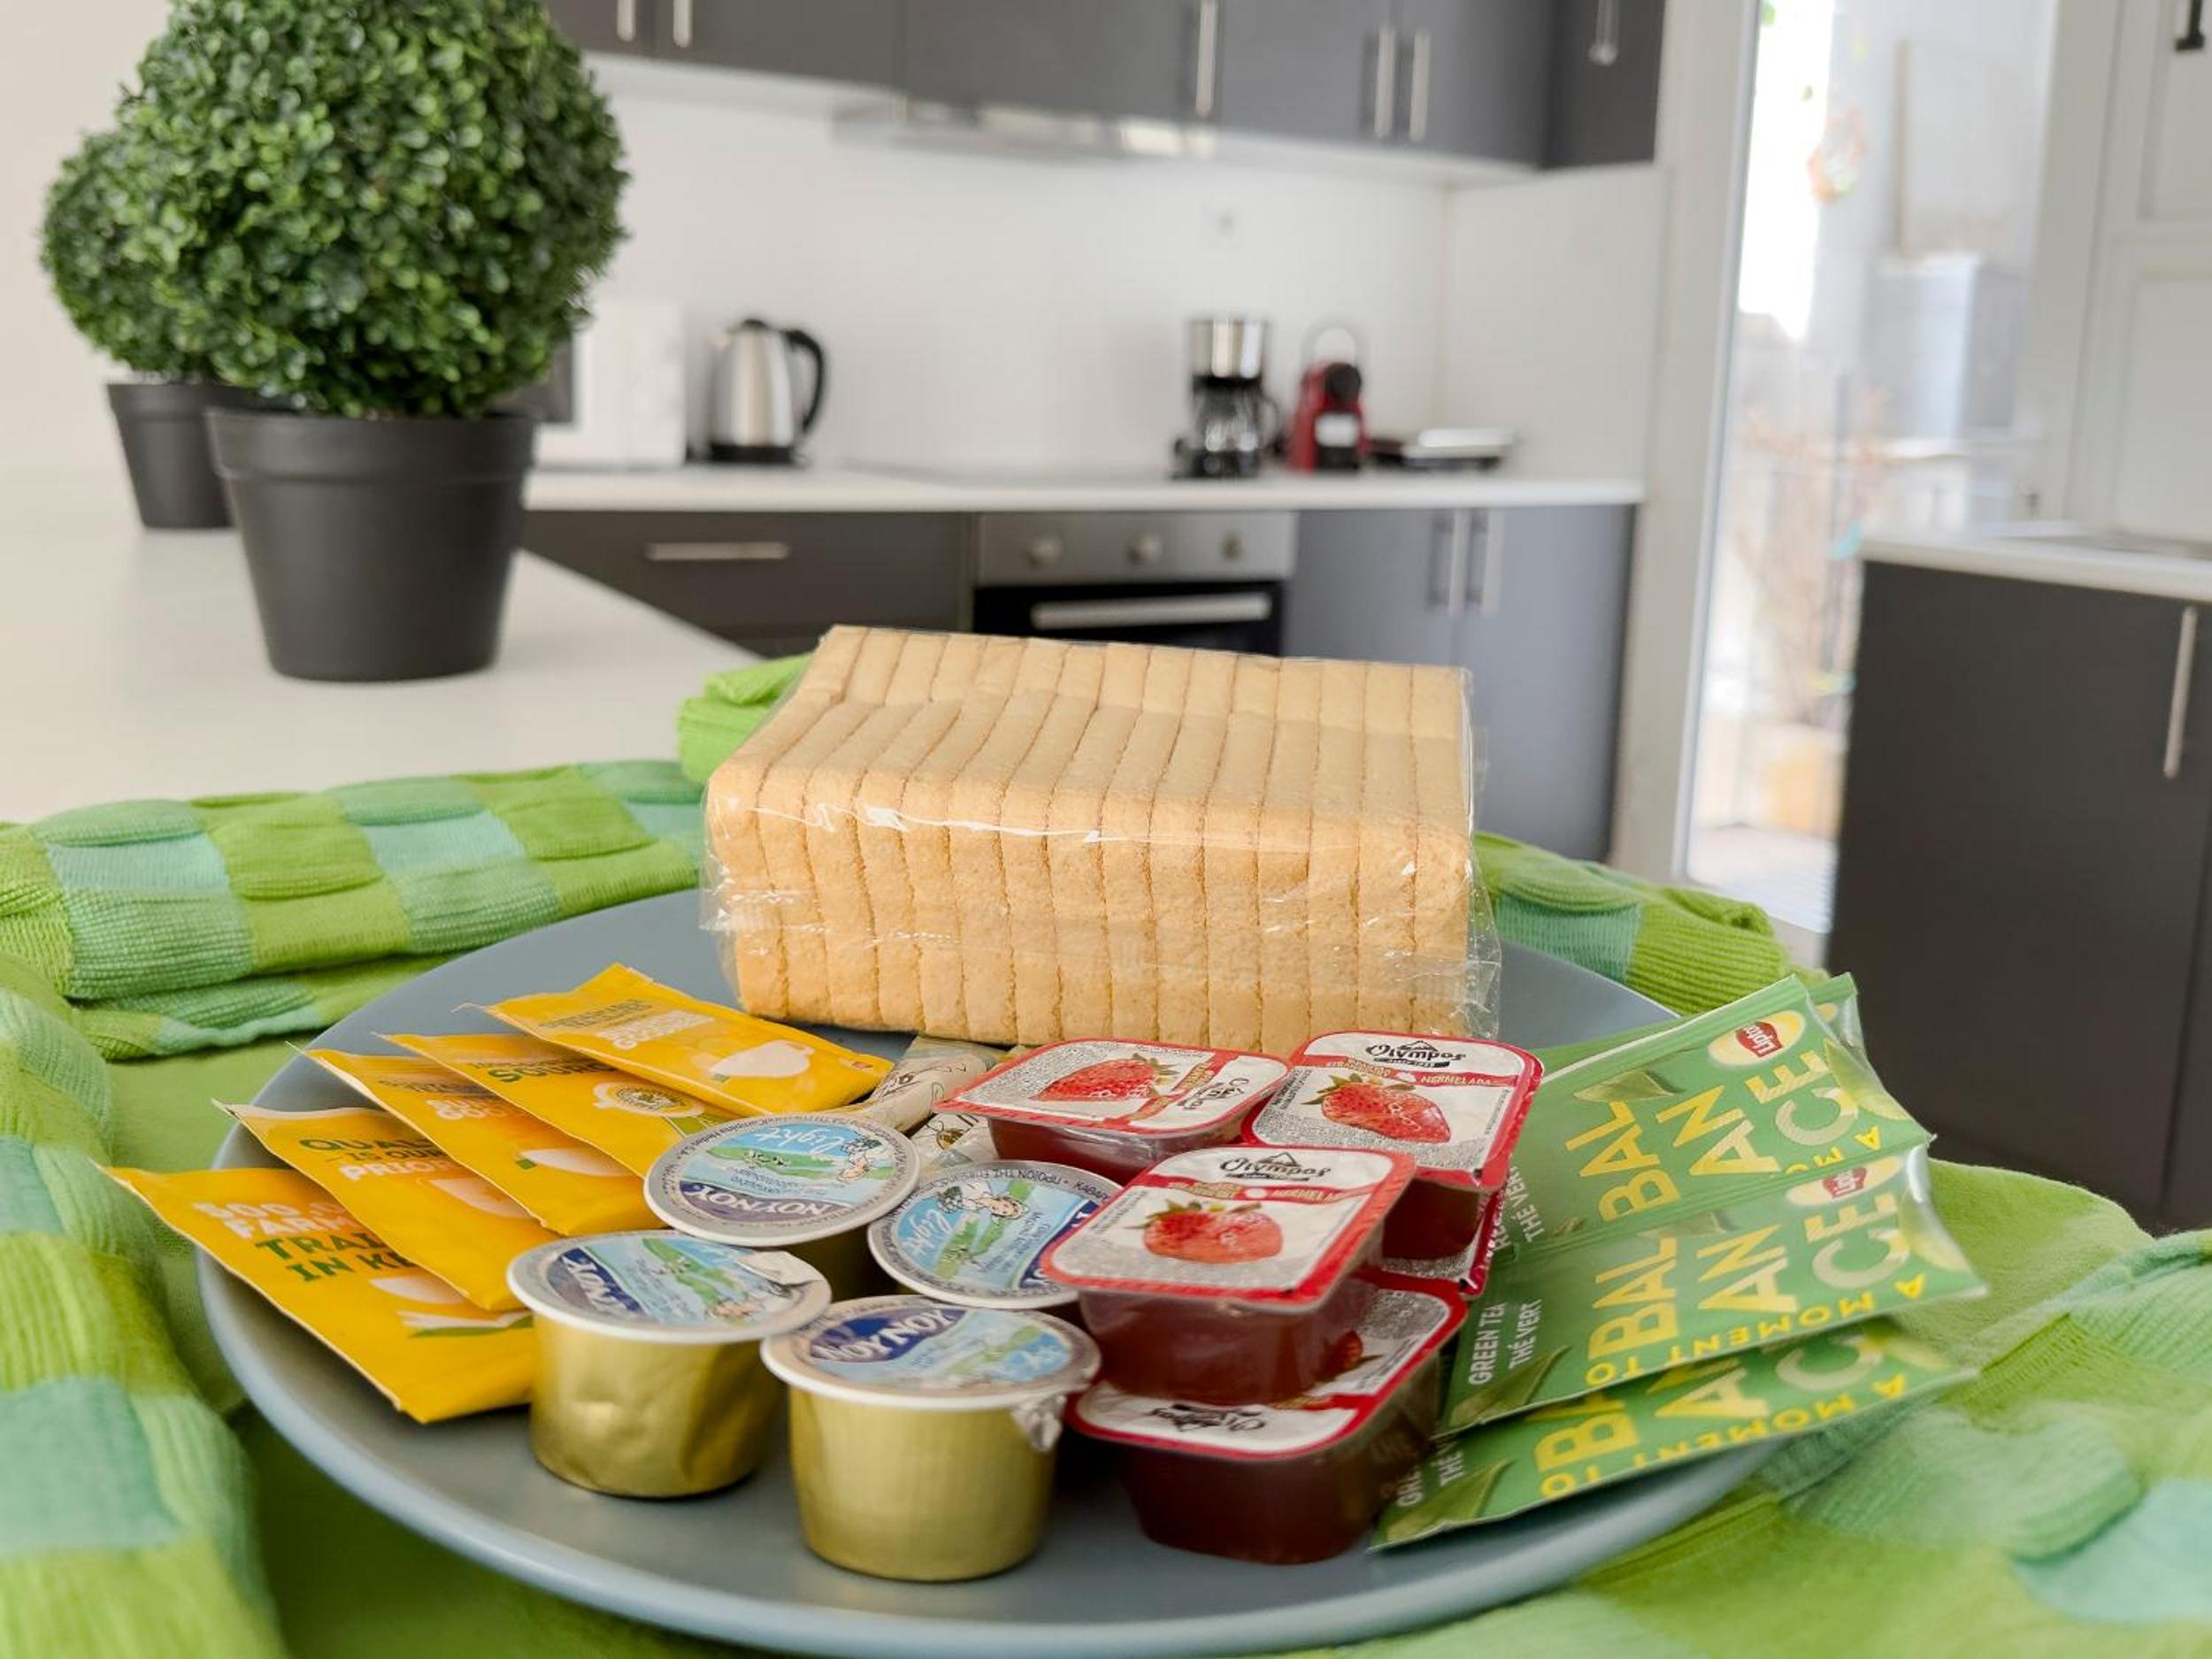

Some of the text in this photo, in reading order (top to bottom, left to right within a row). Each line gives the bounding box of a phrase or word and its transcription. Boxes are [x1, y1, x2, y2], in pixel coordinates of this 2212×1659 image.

[751, 1126, 845, 1155] light
[1563, 1099, 1679, 1222] BAL
[690, 1184, 833, 1216] NOYNOY
[1507, 1298, 1543, 1370] THÉ VERT
[1585, 1273, 1927, 1388] A MOMENT TO
[1587, 1234, 1678, 1361] BAL
[1468, 1302, 1507, 1386] GREEN TEA
